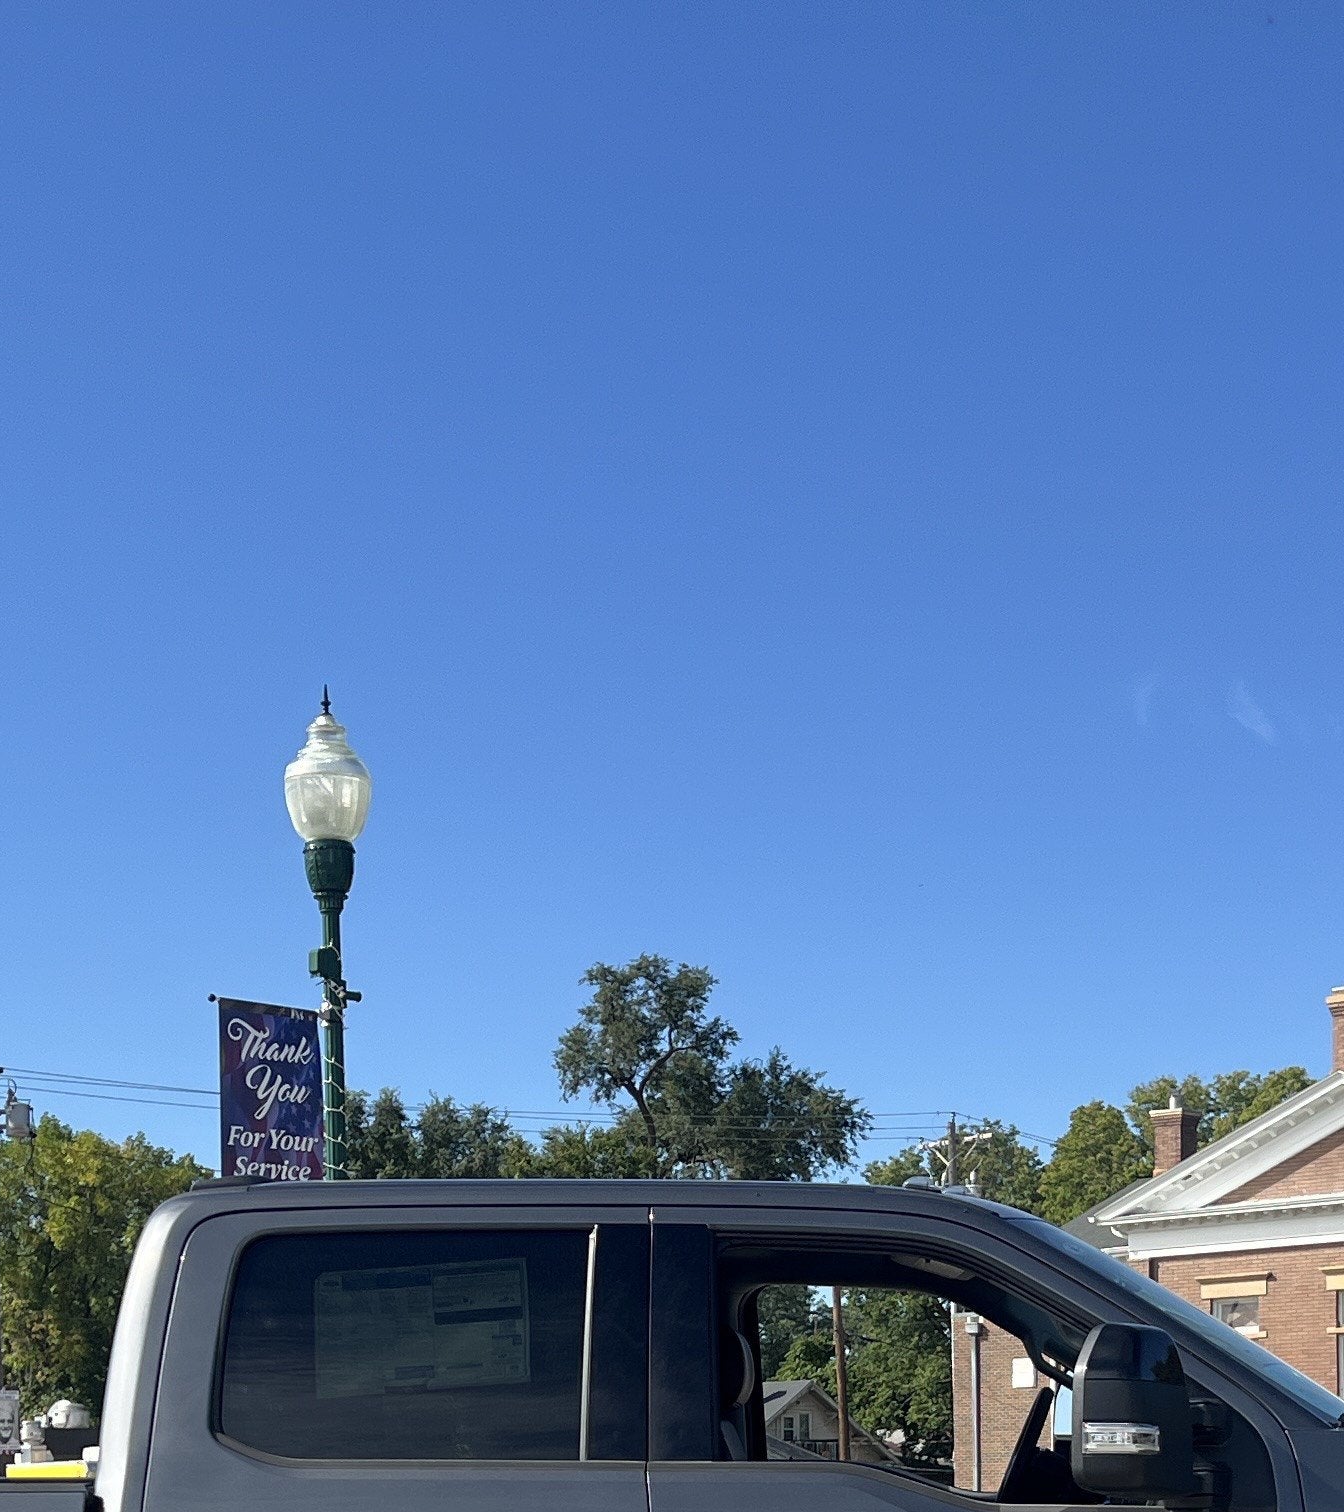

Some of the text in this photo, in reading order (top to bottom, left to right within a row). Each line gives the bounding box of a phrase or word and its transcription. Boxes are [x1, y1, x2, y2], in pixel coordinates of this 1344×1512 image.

[227, 1018, 314, 1065] Thank
[245, 1064, 311, 1120] You
[227, 1125, 319, 1152] For Your
[233, 1155, 312, 1181] Service
